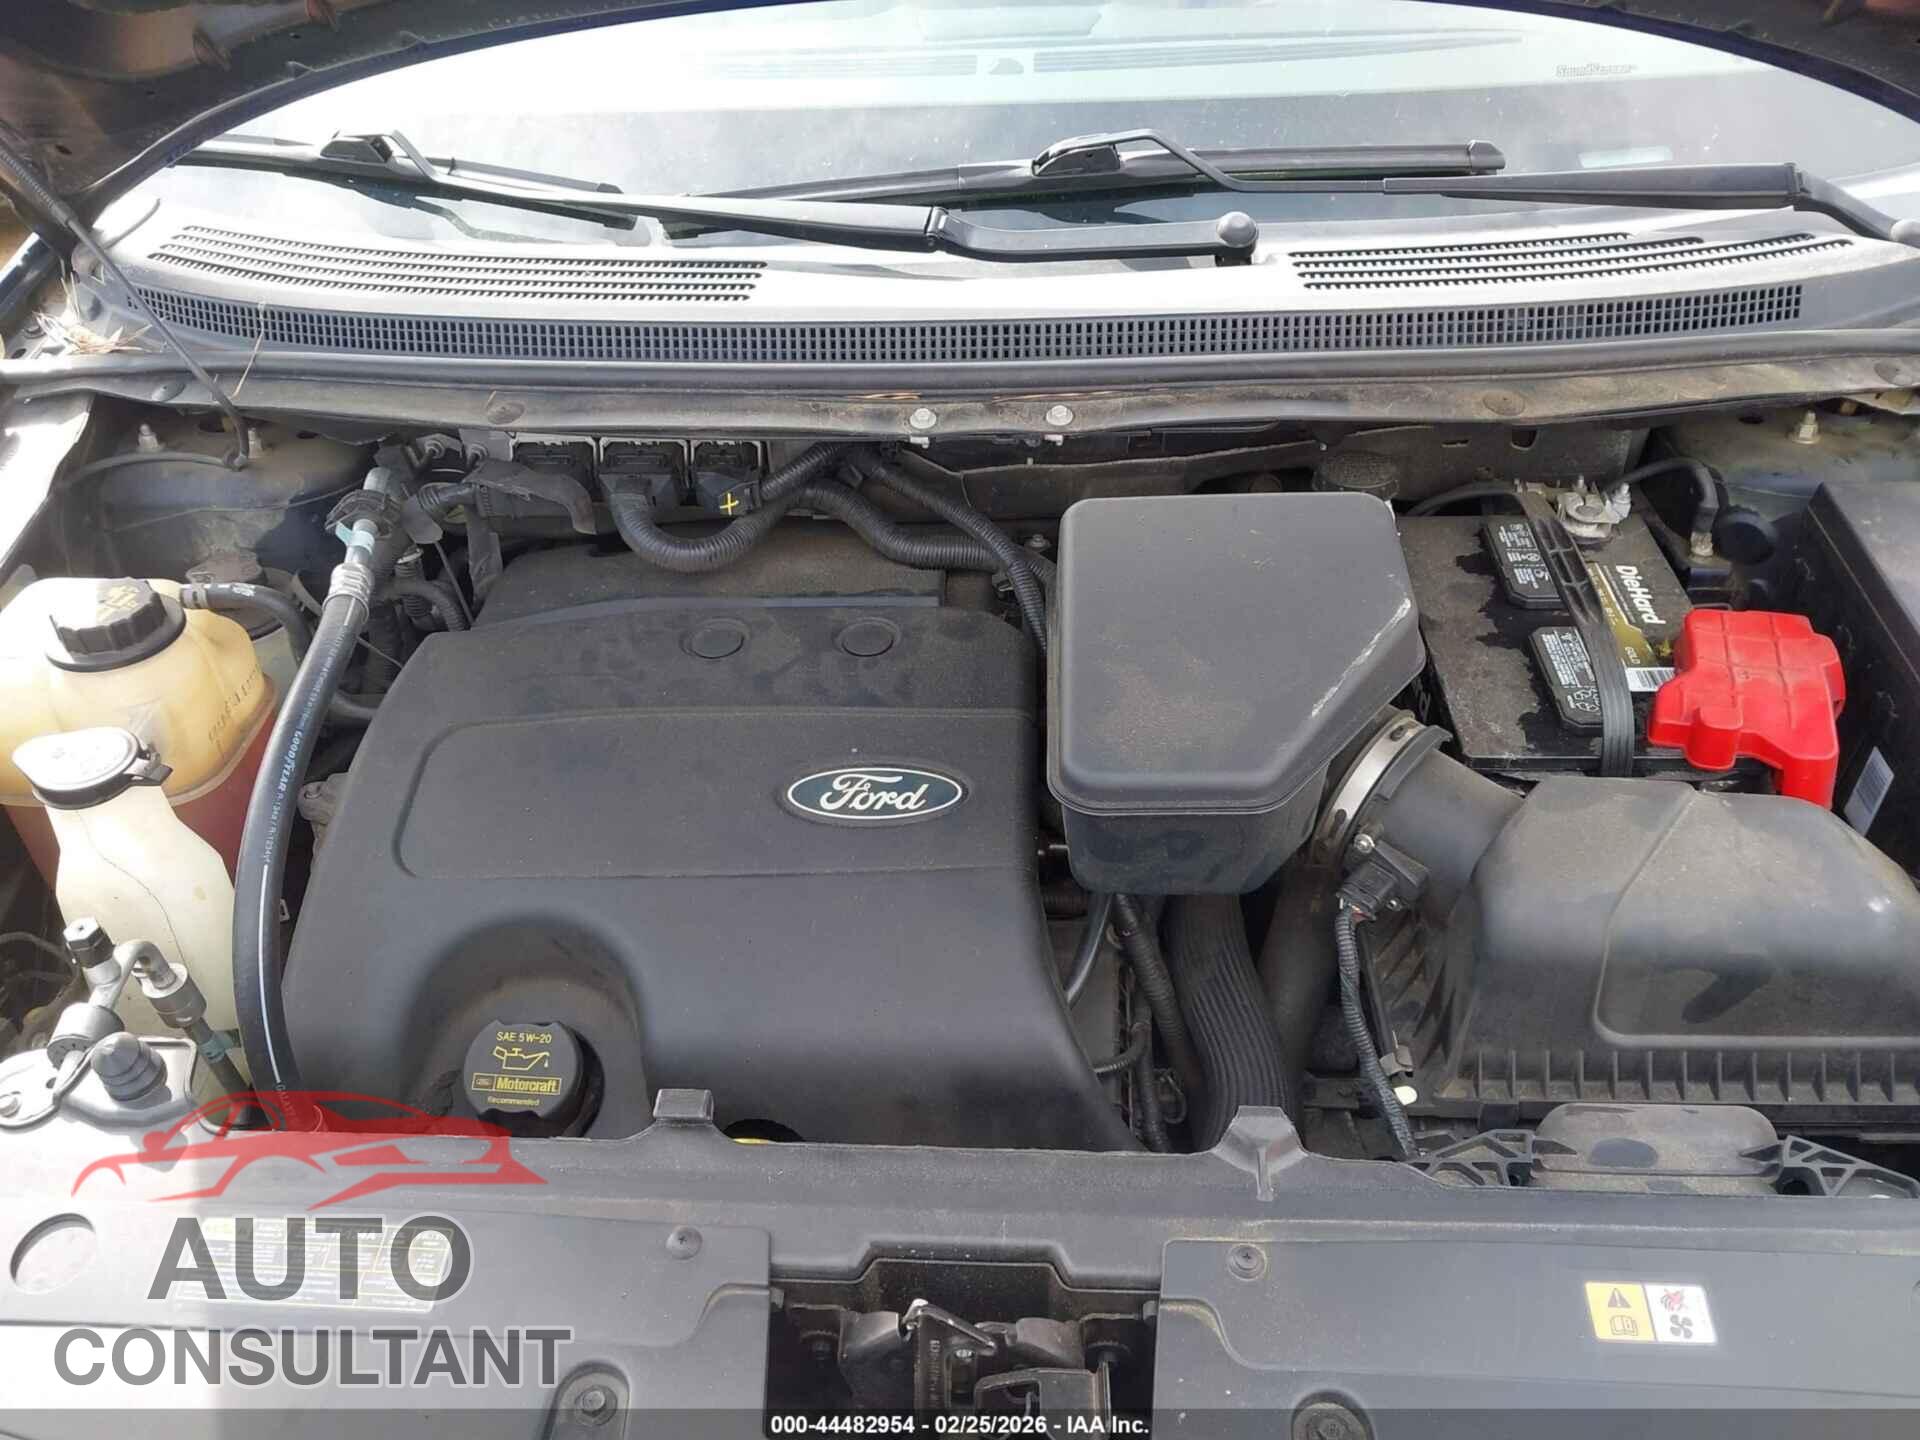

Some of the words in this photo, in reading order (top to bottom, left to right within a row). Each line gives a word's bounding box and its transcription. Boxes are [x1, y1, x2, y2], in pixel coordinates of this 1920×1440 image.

[1615, 565, 1667, 625] DieHard
[278, 730, 303, 792] GOODYEAR
[819, 773, 930, 810] Ford
[496, 1031, 516, 1043] SAE
[518, 1031, 553, 1044] 5W-20
[496, 1077, 558, 1093] Motorcraft
